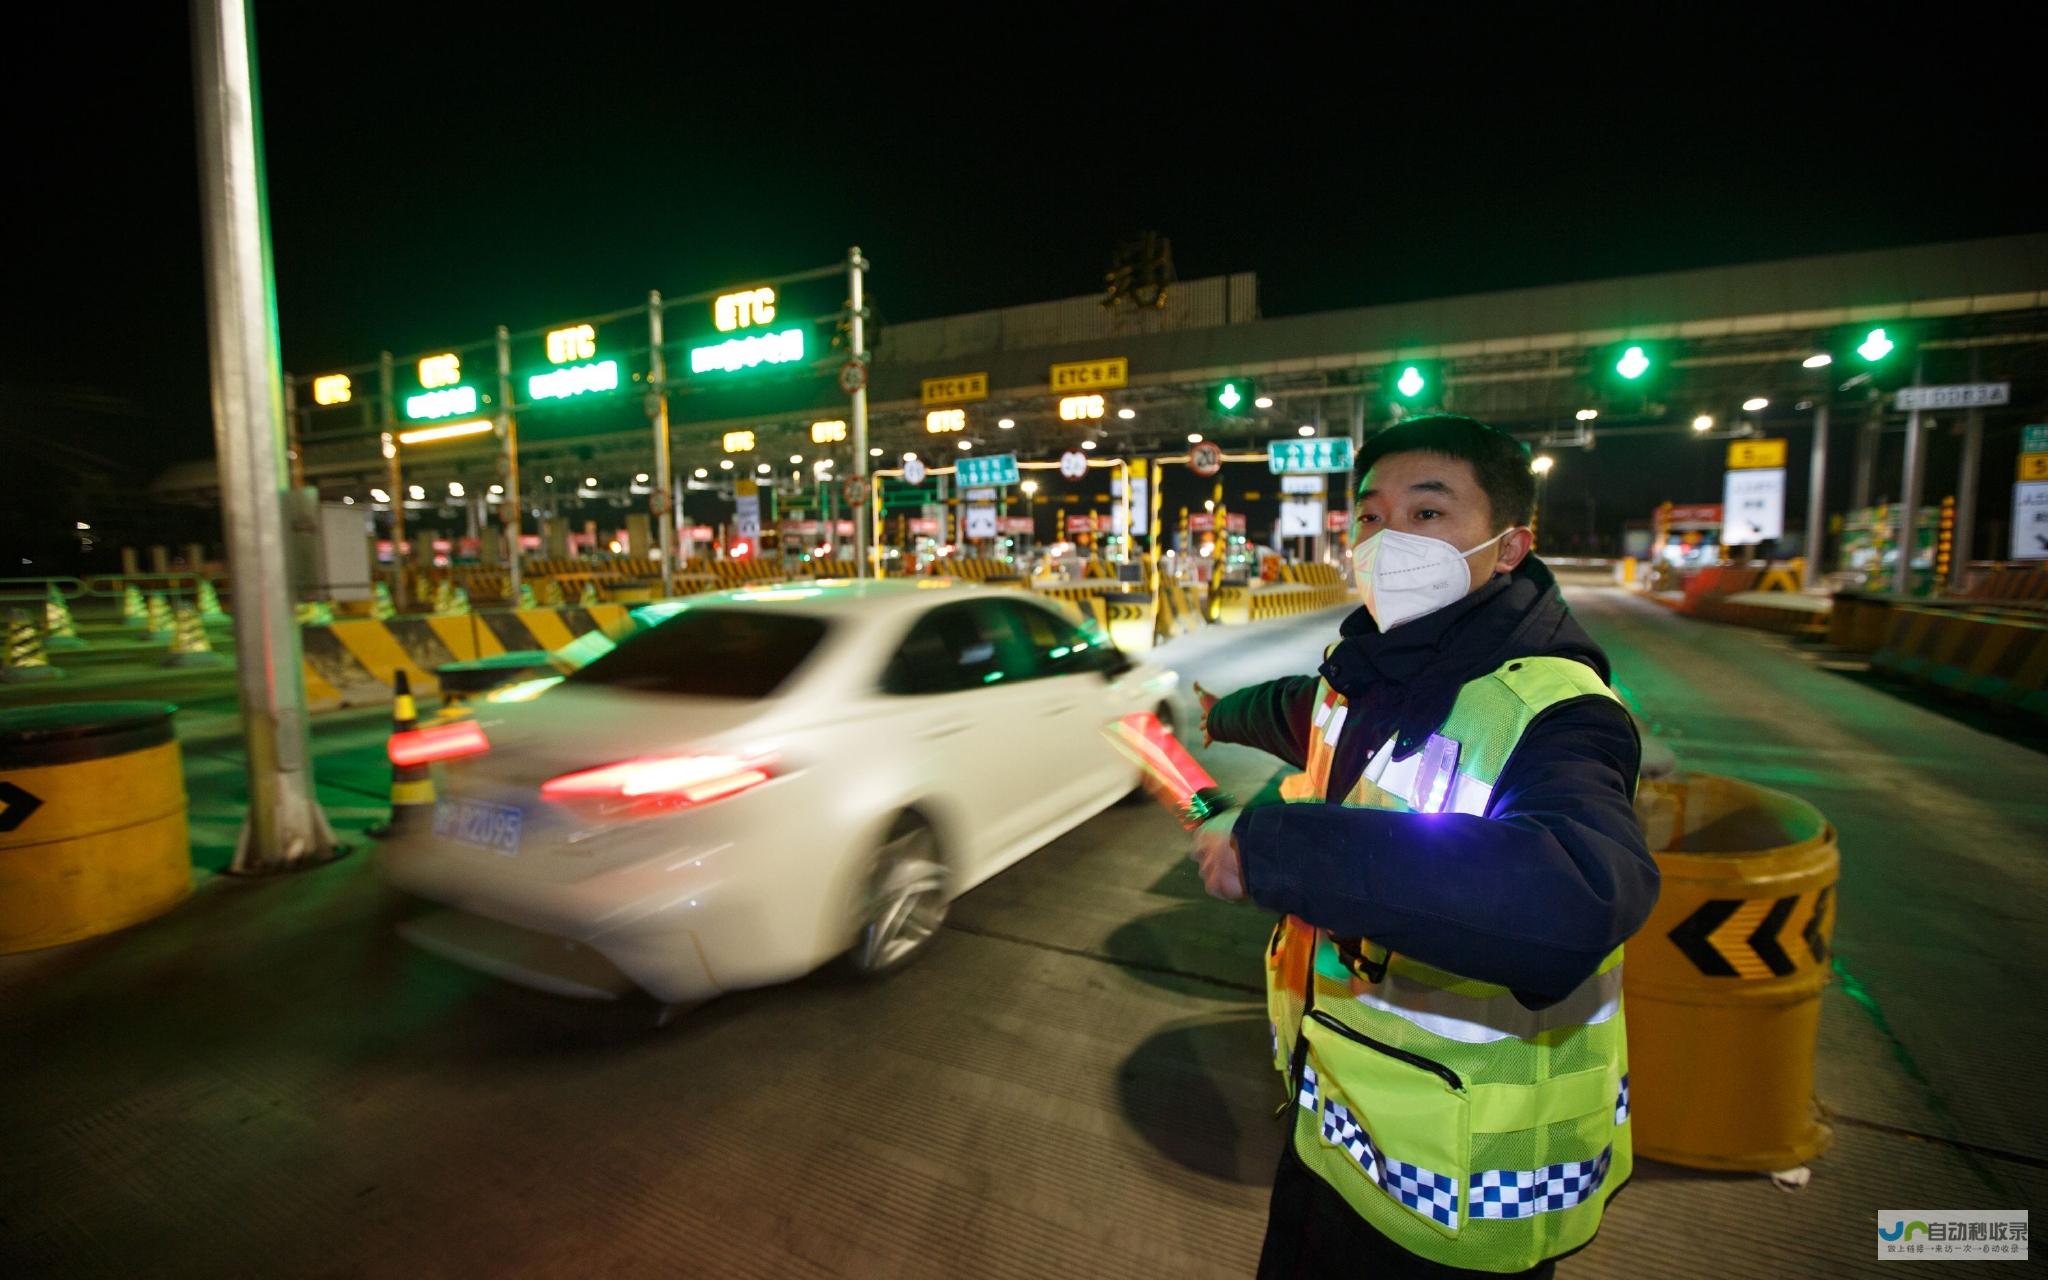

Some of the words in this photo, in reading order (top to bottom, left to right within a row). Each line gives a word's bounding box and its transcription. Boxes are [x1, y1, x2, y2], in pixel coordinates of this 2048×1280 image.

[715, 287, 775, 332] ETC
[547, 324, 596, 364] ETC
[1060, 395, 1105, 420] ETC
